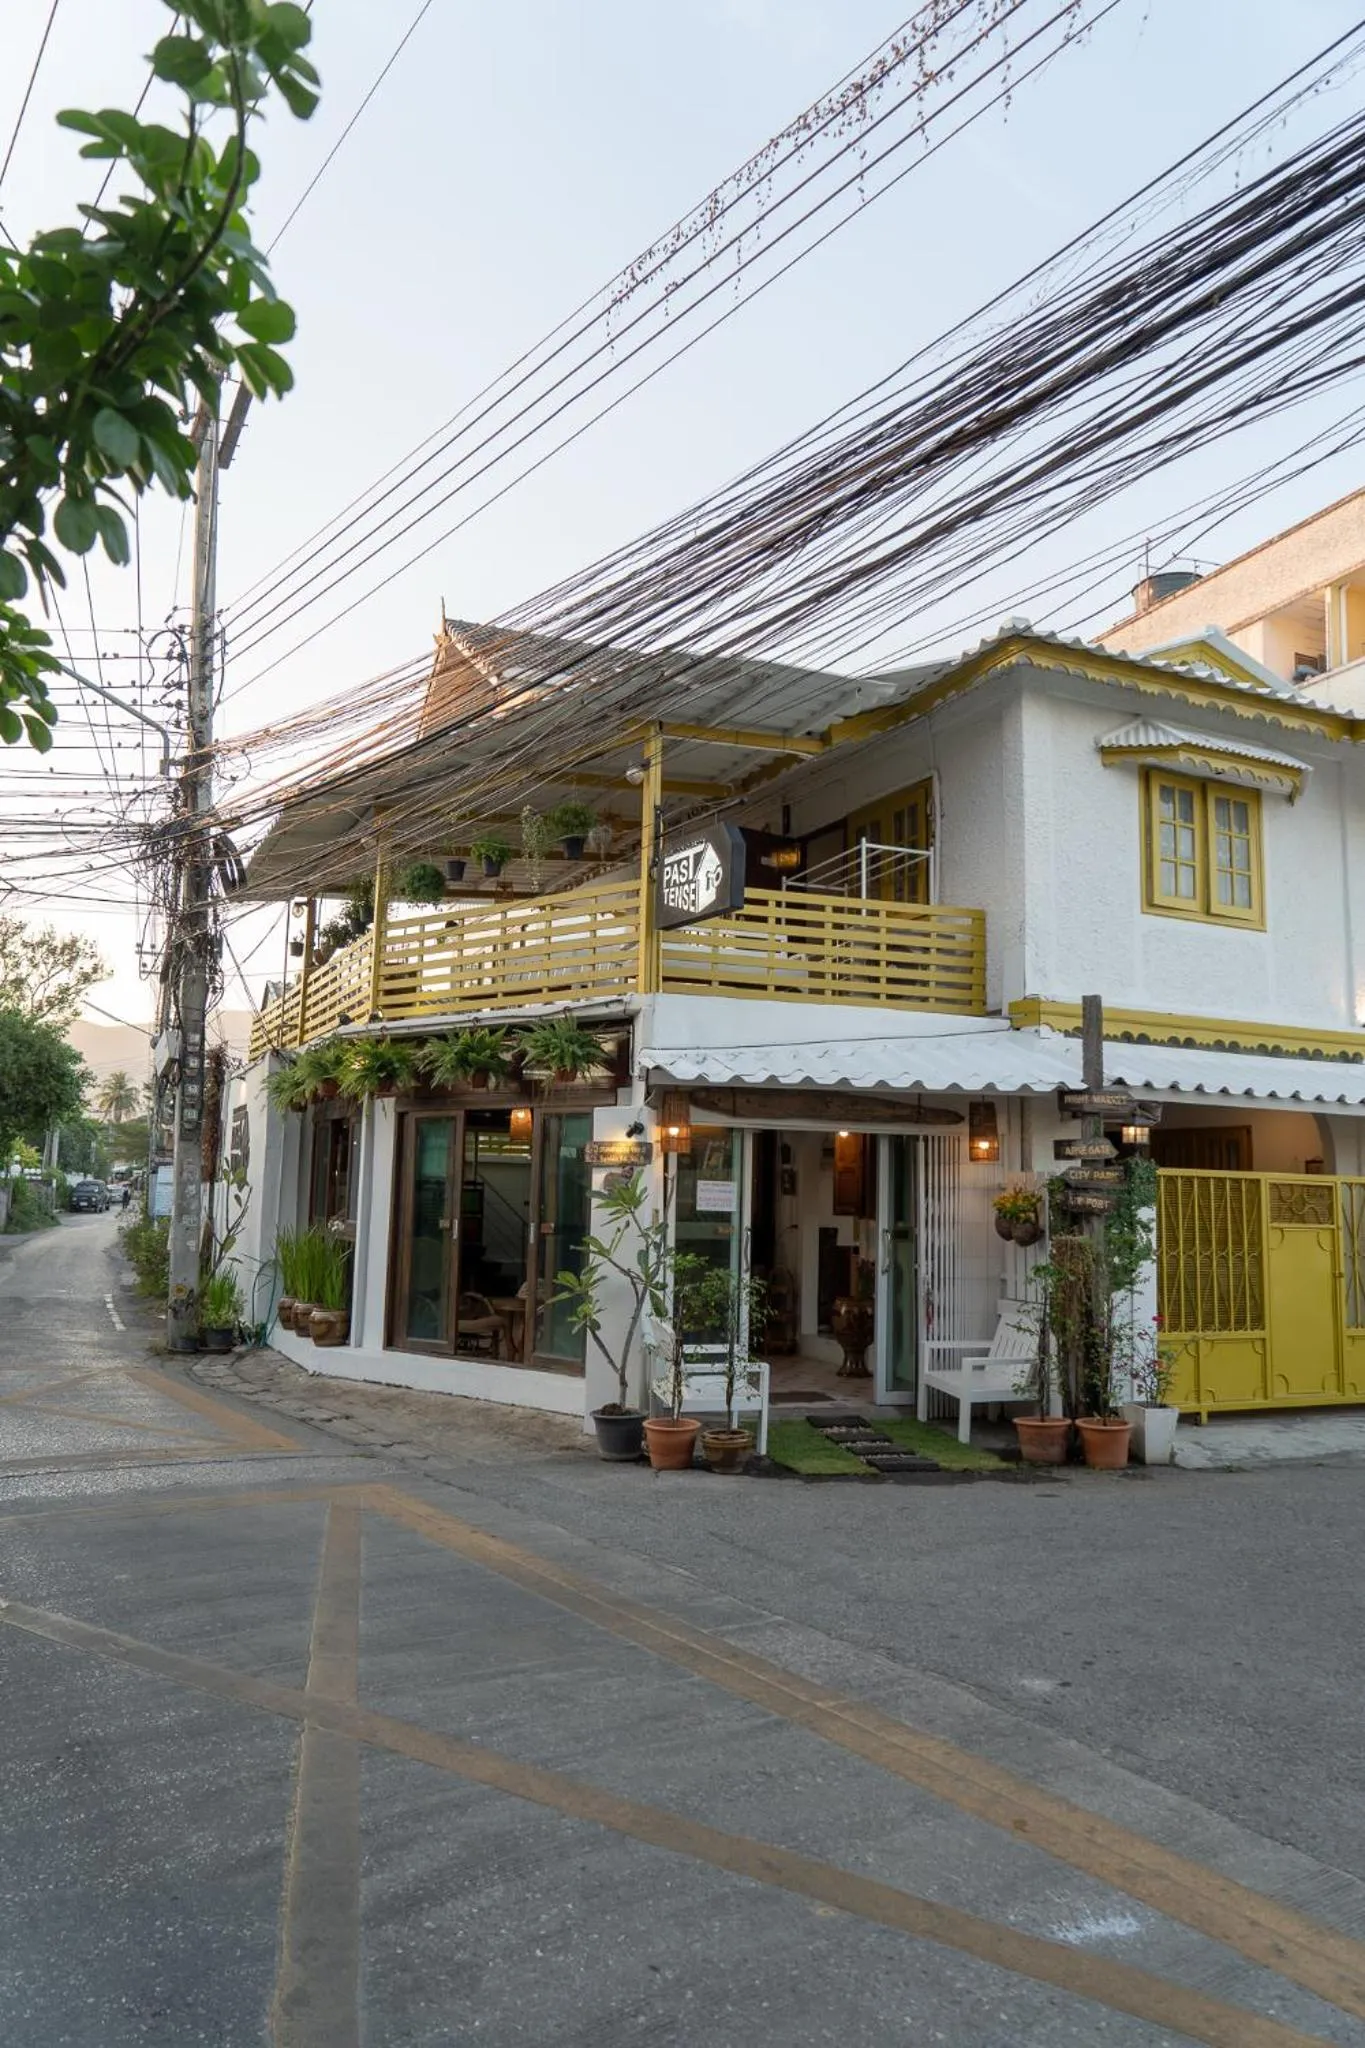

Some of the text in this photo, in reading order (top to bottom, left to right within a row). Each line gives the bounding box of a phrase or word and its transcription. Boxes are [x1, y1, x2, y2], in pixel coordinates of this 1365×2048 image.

[664, 846, 702, 888] PAST
[664, 882, 696, 913] TENSE
[1069, 1170, 1090, 1180] CITY
